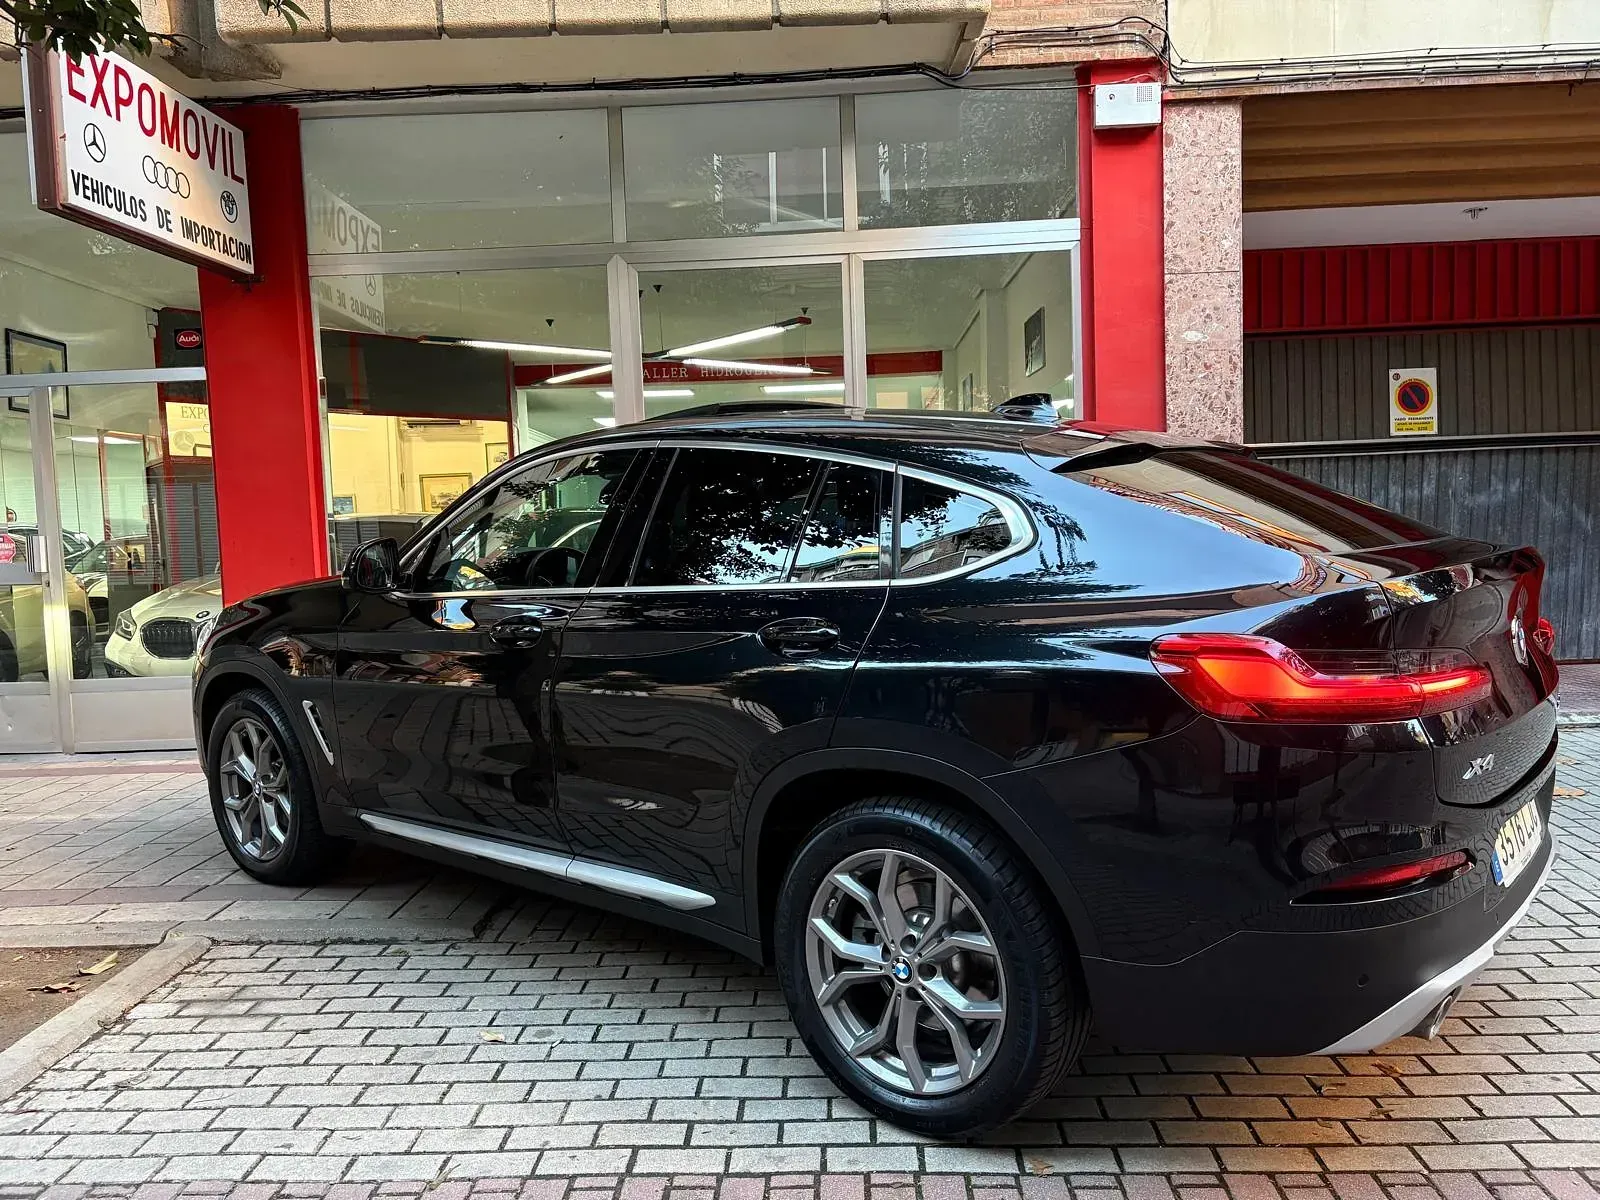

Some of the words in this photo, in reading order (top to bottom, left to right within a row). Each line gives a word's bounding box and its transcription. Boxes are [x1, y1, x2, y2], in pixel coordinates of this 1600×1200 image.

[66, 52, 244, 185] EXPOMOVIL
[71, 169, 147, 222] VEHICULOS
[156, 206, 173, 233] DE
[181, 216, 252, 265] IMPORTACION
[179, 334, 200, 343] Audi
[643, 367, 689, 379] ALLER
[1462, 753, 1495, 780] X4
[1498, 813, 1527, 867] 3516
